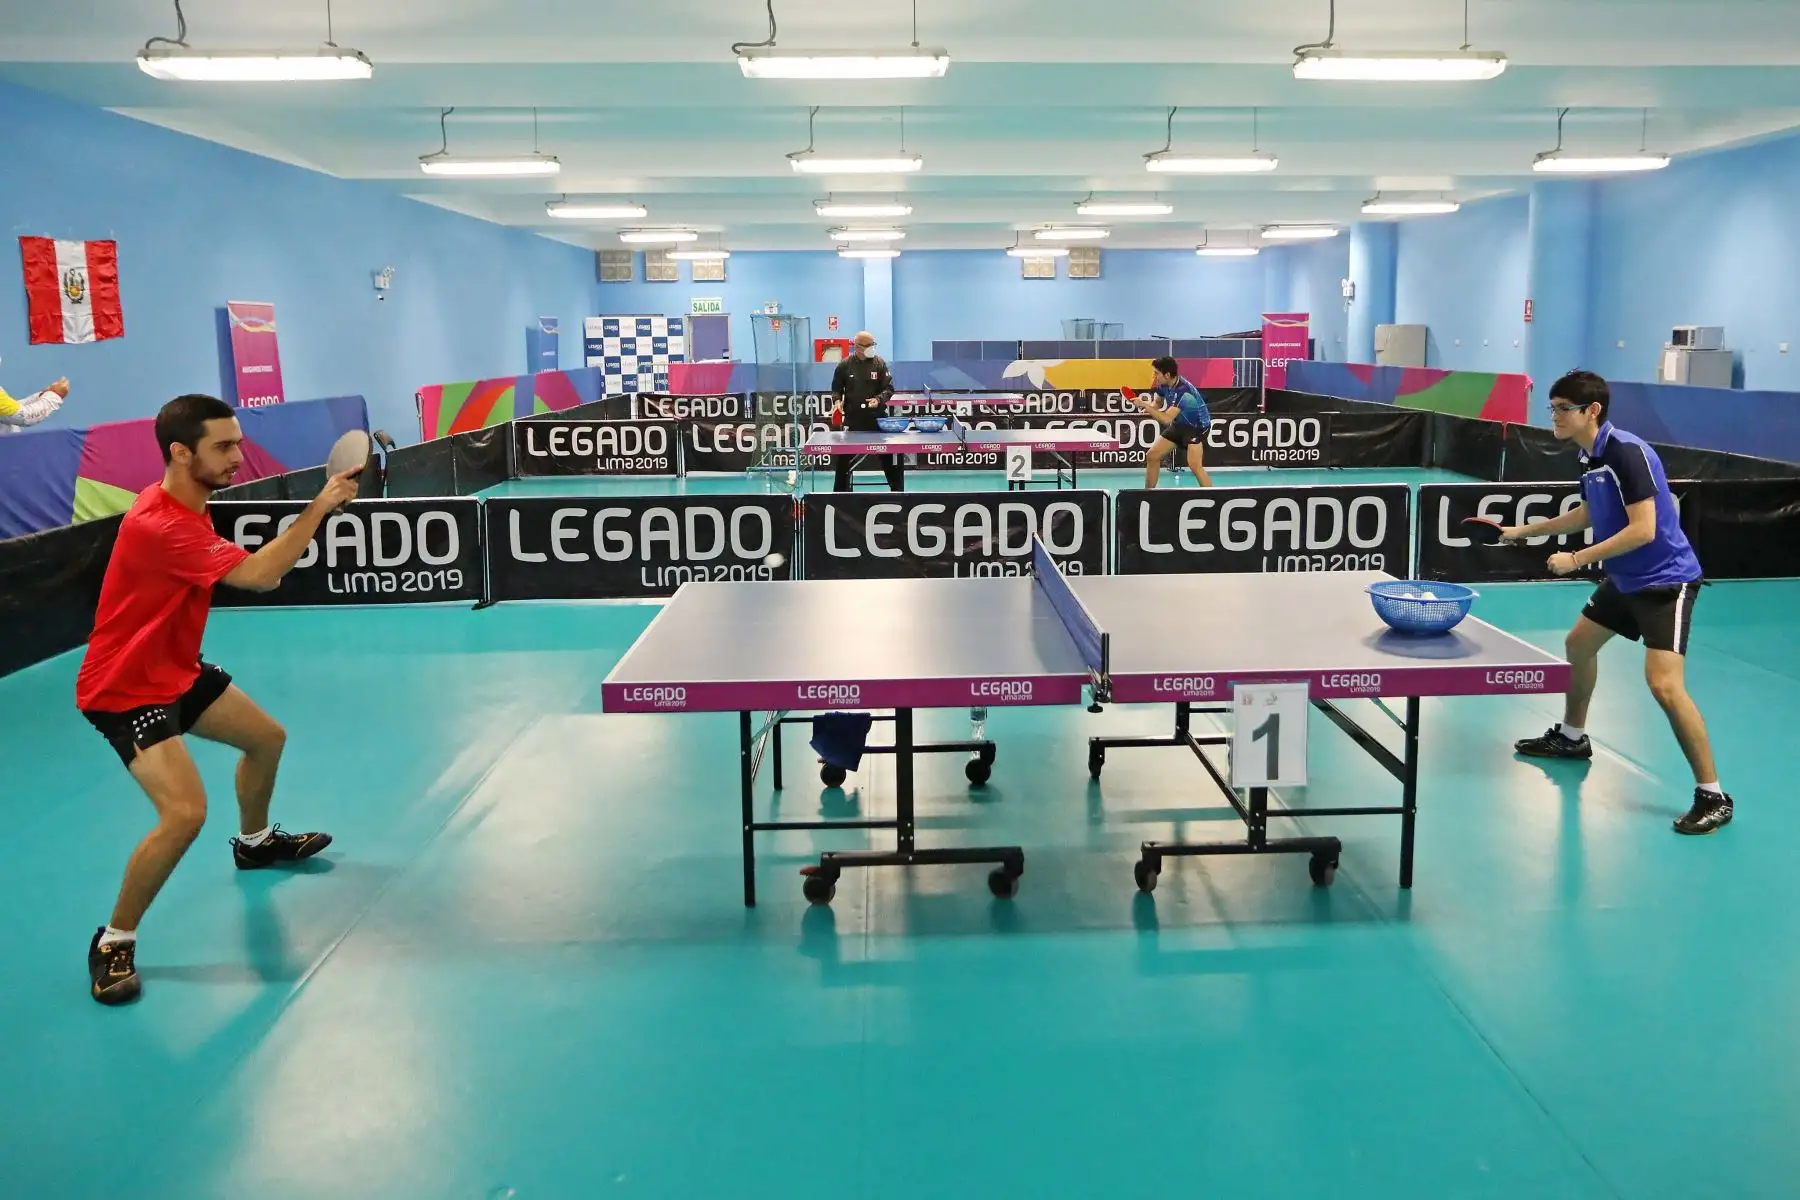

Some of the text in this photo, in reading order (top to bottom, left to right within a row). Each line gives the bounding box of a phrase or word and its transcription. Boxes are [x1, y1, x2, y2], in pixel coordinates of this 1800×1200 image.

[693, 302, 720, 312] SALIDA
[645, 397, 738, 418] LEGADO
[759, 394, 834, 416] LEGAD
[527, 425, 668, 456] LEGADO
[1207, 418, 1320, 448] EGADO
[1011, 455, 1026, 478] 2
[509, 505, 772, 562] LEGADO
[824, 502, 1083, 558] LEGADO
[1139, 495, 1387, 553] LEGADO
[1153, 677, 1215, 691] LEGADO
[1321, 673, 1381, 688] LEGADO
[1486, 670, 1545, 684] LEGADO
[623, 687, 686, 702] LEGADO
[797, 685, 860, 699] LEGADO
[970, 681, 1033, 696] LEGADO
[1252, 713, 1280, 780] 1
